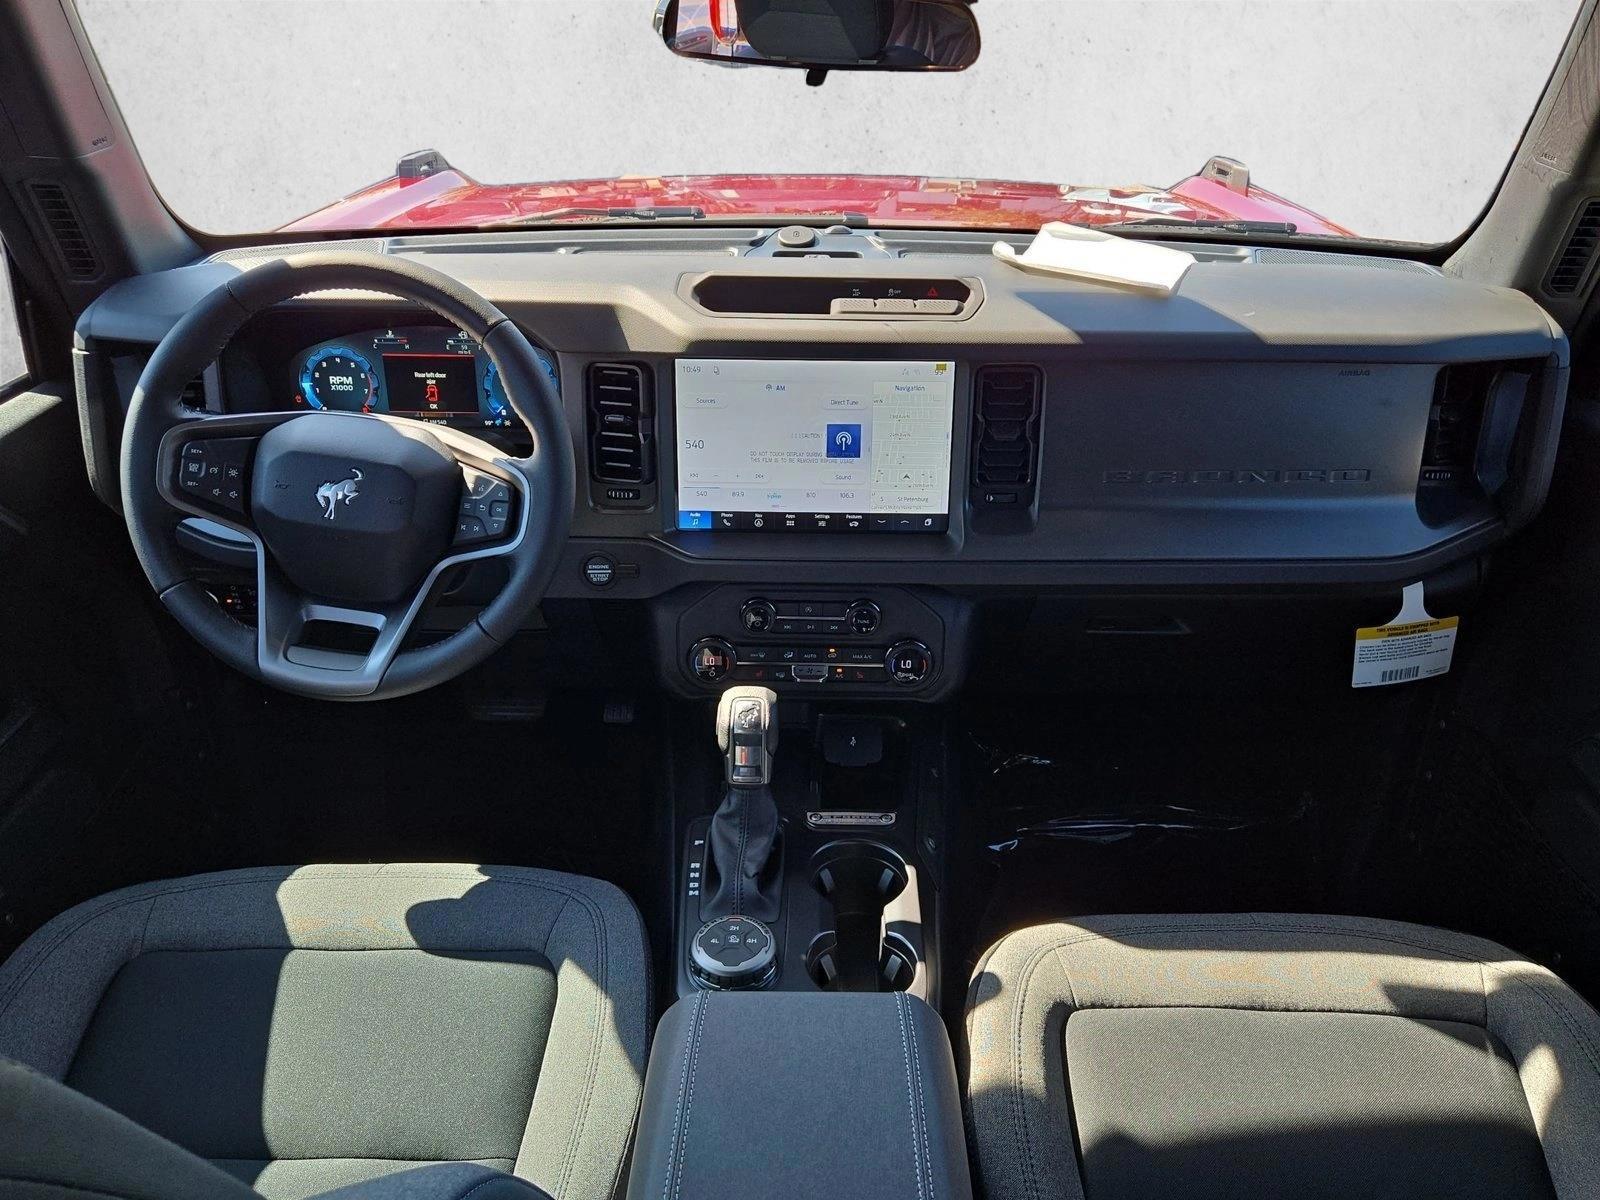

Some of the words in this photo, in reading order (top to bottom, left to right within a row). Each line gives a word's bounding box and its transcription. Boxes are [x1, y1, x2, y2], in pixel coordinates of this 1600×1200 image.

[682, 366, 701, 374] 10:49
[329, 376, 353, 385] RPM
[685, 439, 705, 450] 540
[1101, 467, 1371, 484] BRONCO
[704, 657, 715, 666] LO
[901, 660, 912, 669] LO
